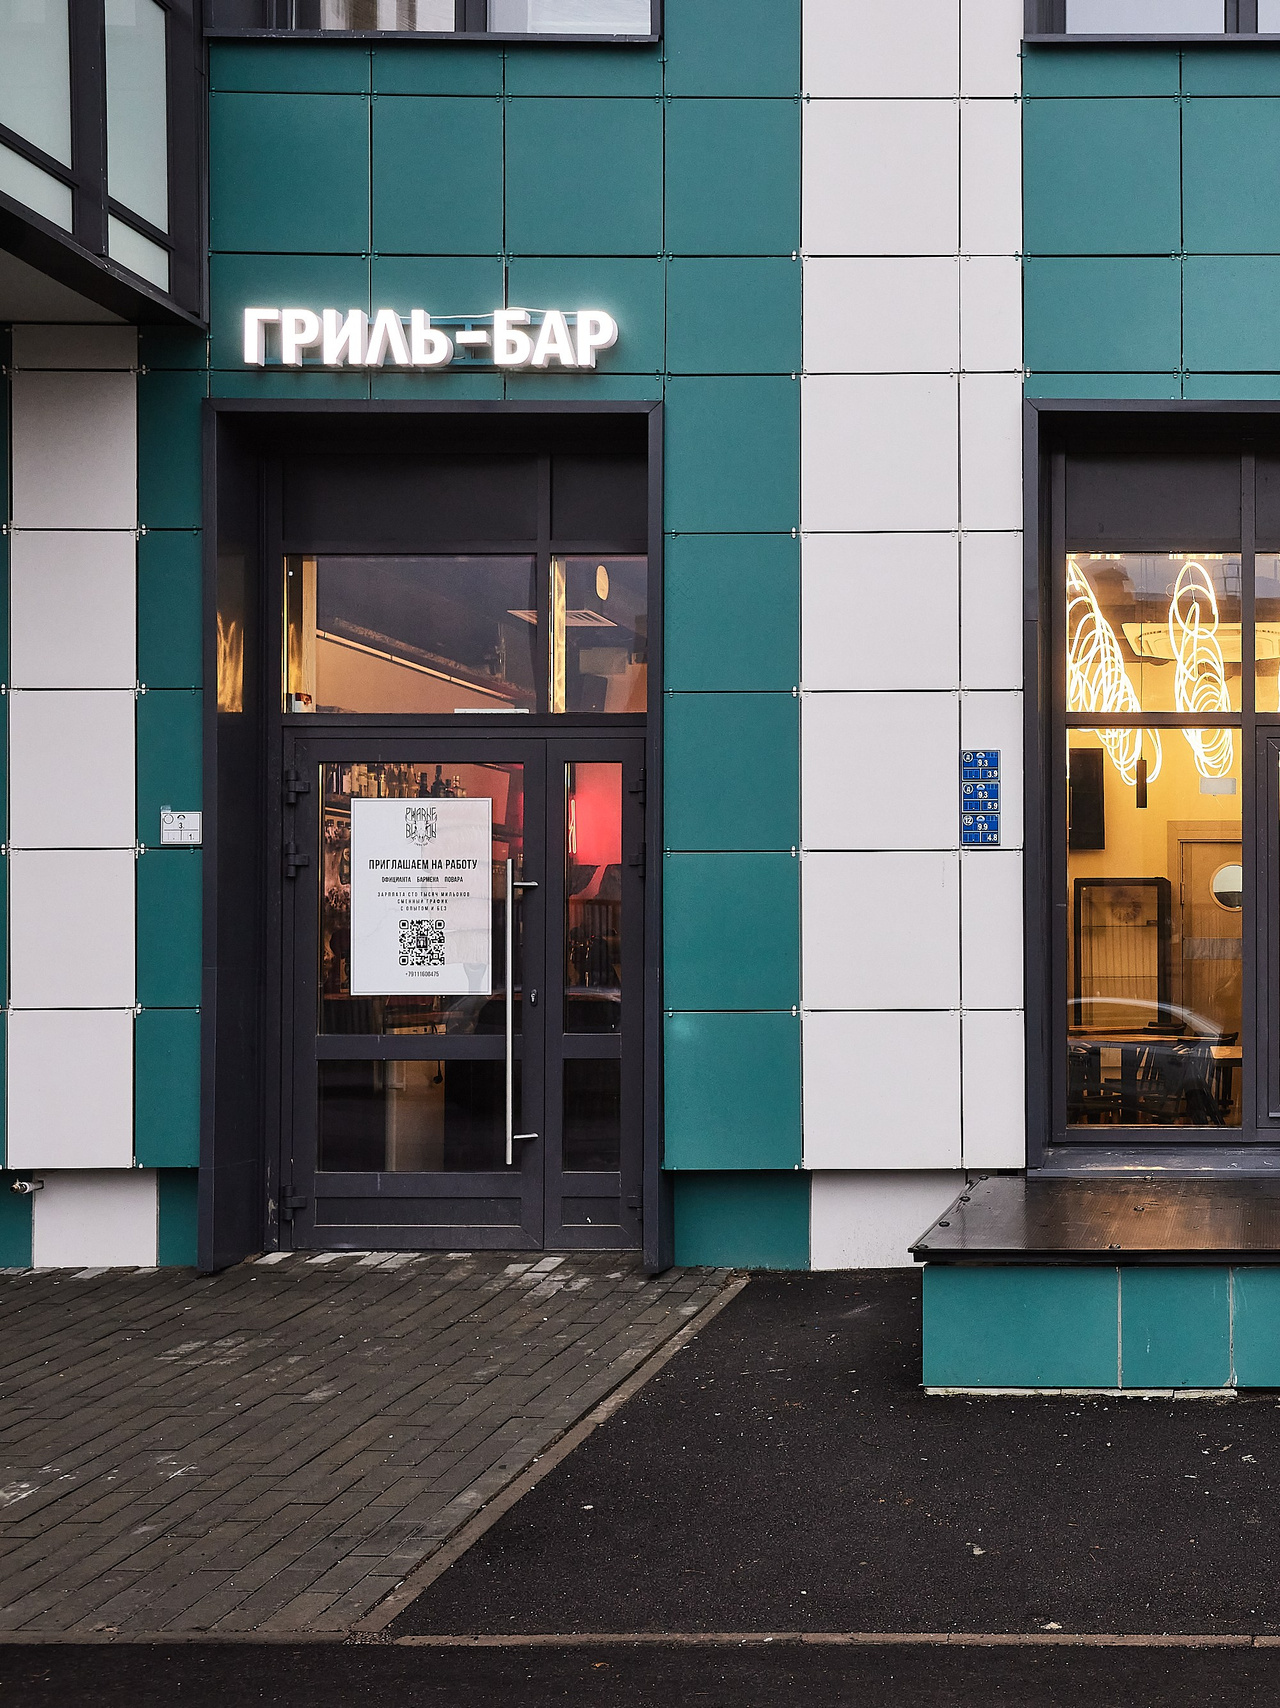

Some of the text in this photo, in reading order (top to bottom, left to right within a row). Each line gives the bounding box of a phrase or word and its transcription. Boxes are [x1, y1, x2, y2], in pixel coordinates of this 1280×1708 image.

[243, 308, 619, 369] ГРИЛЬ-БАР
[368, 859, 478, 870] ПРИГЛАШАЕМ НА РАБОТУ
[381, 876, 412, 884] ОФИЦИАНТА
